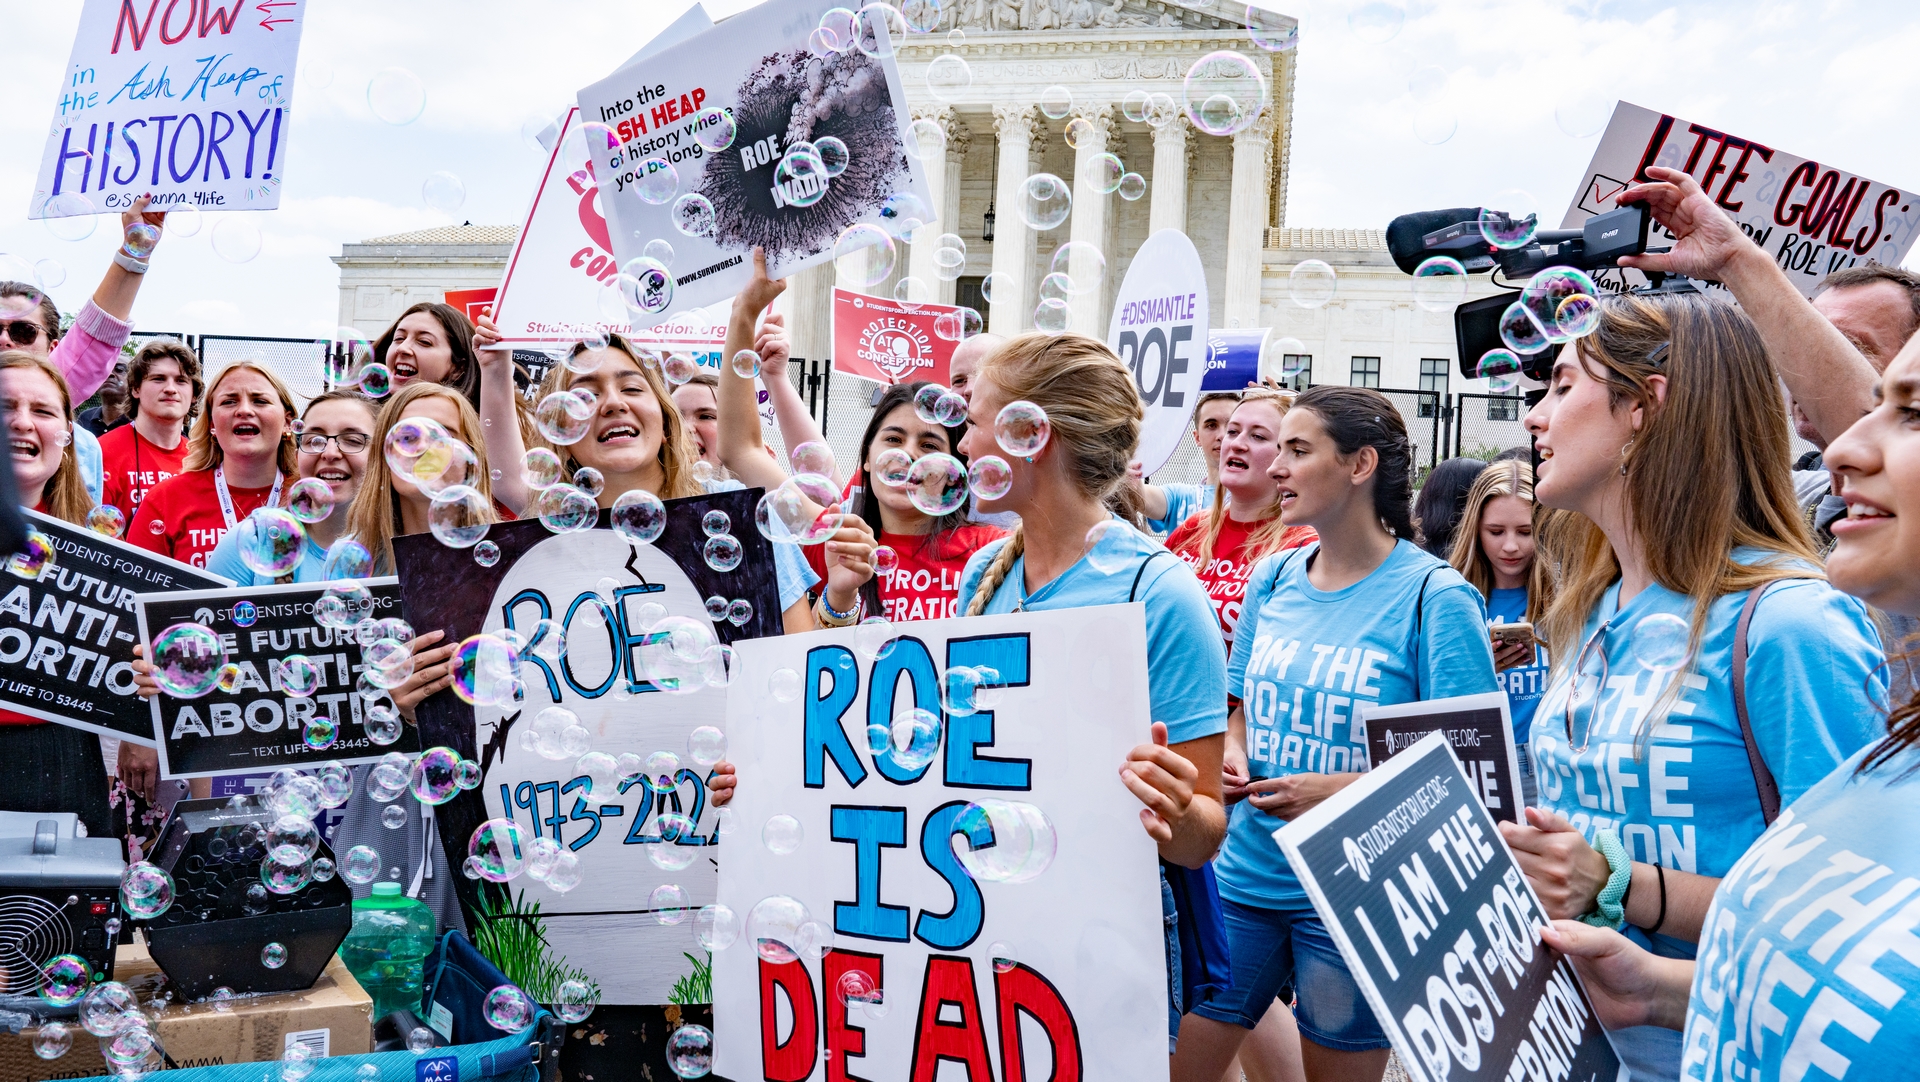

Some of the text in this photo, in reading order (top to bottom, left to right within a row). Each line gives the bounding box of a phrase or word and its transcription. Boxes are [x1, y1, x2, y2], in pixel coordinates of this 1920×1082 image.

[111, 0, 247, 54] NOW
[60, 53, 284, 116] in the Ash Heap of
[992, 64, 1046, 77] UNDER
[1051, 63, 1084, 77] LAW
[600, 83, 666, 123] Into the
[607, 87, 707, 151] ASH HEAP
[52, 107, 283, 197] HISTORY!
[610, 105, 734, 169] of history where
[739, 133, 783, 172] ROE
[615, 166, 645, 193] you
[646, 143, 703, 175] belong
[770, 172, 830, 209] WADE
[1774, 160, 1911, 256] GOALS:
[677, 254, 743, 287] WWW.SURVIVORS.LA
[1776, 233, 1826, 277] ROE
[1120, 293, 1196, 327] #DISMANTLE
[857, 349, 934, 368] CONCEPTION
[859, 317, 933, 355] PROTECTION
[878, 335, 893, 348] AT
[127, 471, 156, 486] THE
[36, 562, 137, 614] FUTUR
[113, 558, 143, 578] FOR
[145, 569, 173, 588] LIFE
[0, 584, 135, 648] ANTI-
[216, 596, 393, 622] STUDENTSFORLIFE.ORG
[174, 632, 239, 658] THE
[251, 624, 375, 653] FUTURE
[501, 583, 680, 704] ROE
[8, 679, 36, 697] LIFE
[37, 688, 55, 702] TO
[56, 693, 94, 713] 53445
[229, 652, 371, 695] ANTI-
[1306, 643, 1389, 698] THE
[803, 632, 1033, 792] ROE
[1591, 671, 1709, 741] THE
[252, 745, 280, 758] TEXT
[284, 744, 309, 755] LIFE
[332, 738, 370, 751] 53445
[1357, 775, 1450, 864] STUDENTSFORLIFE.ORG
[830, 800, 998, 951] IS
[1354, 803, 1495, 983] I AM THE
[1762, 849, 1920, 1011] THE
[1402, 865, 1545, 1082] POST-ROE
[757, 938, 1084, 1082] DEAD
